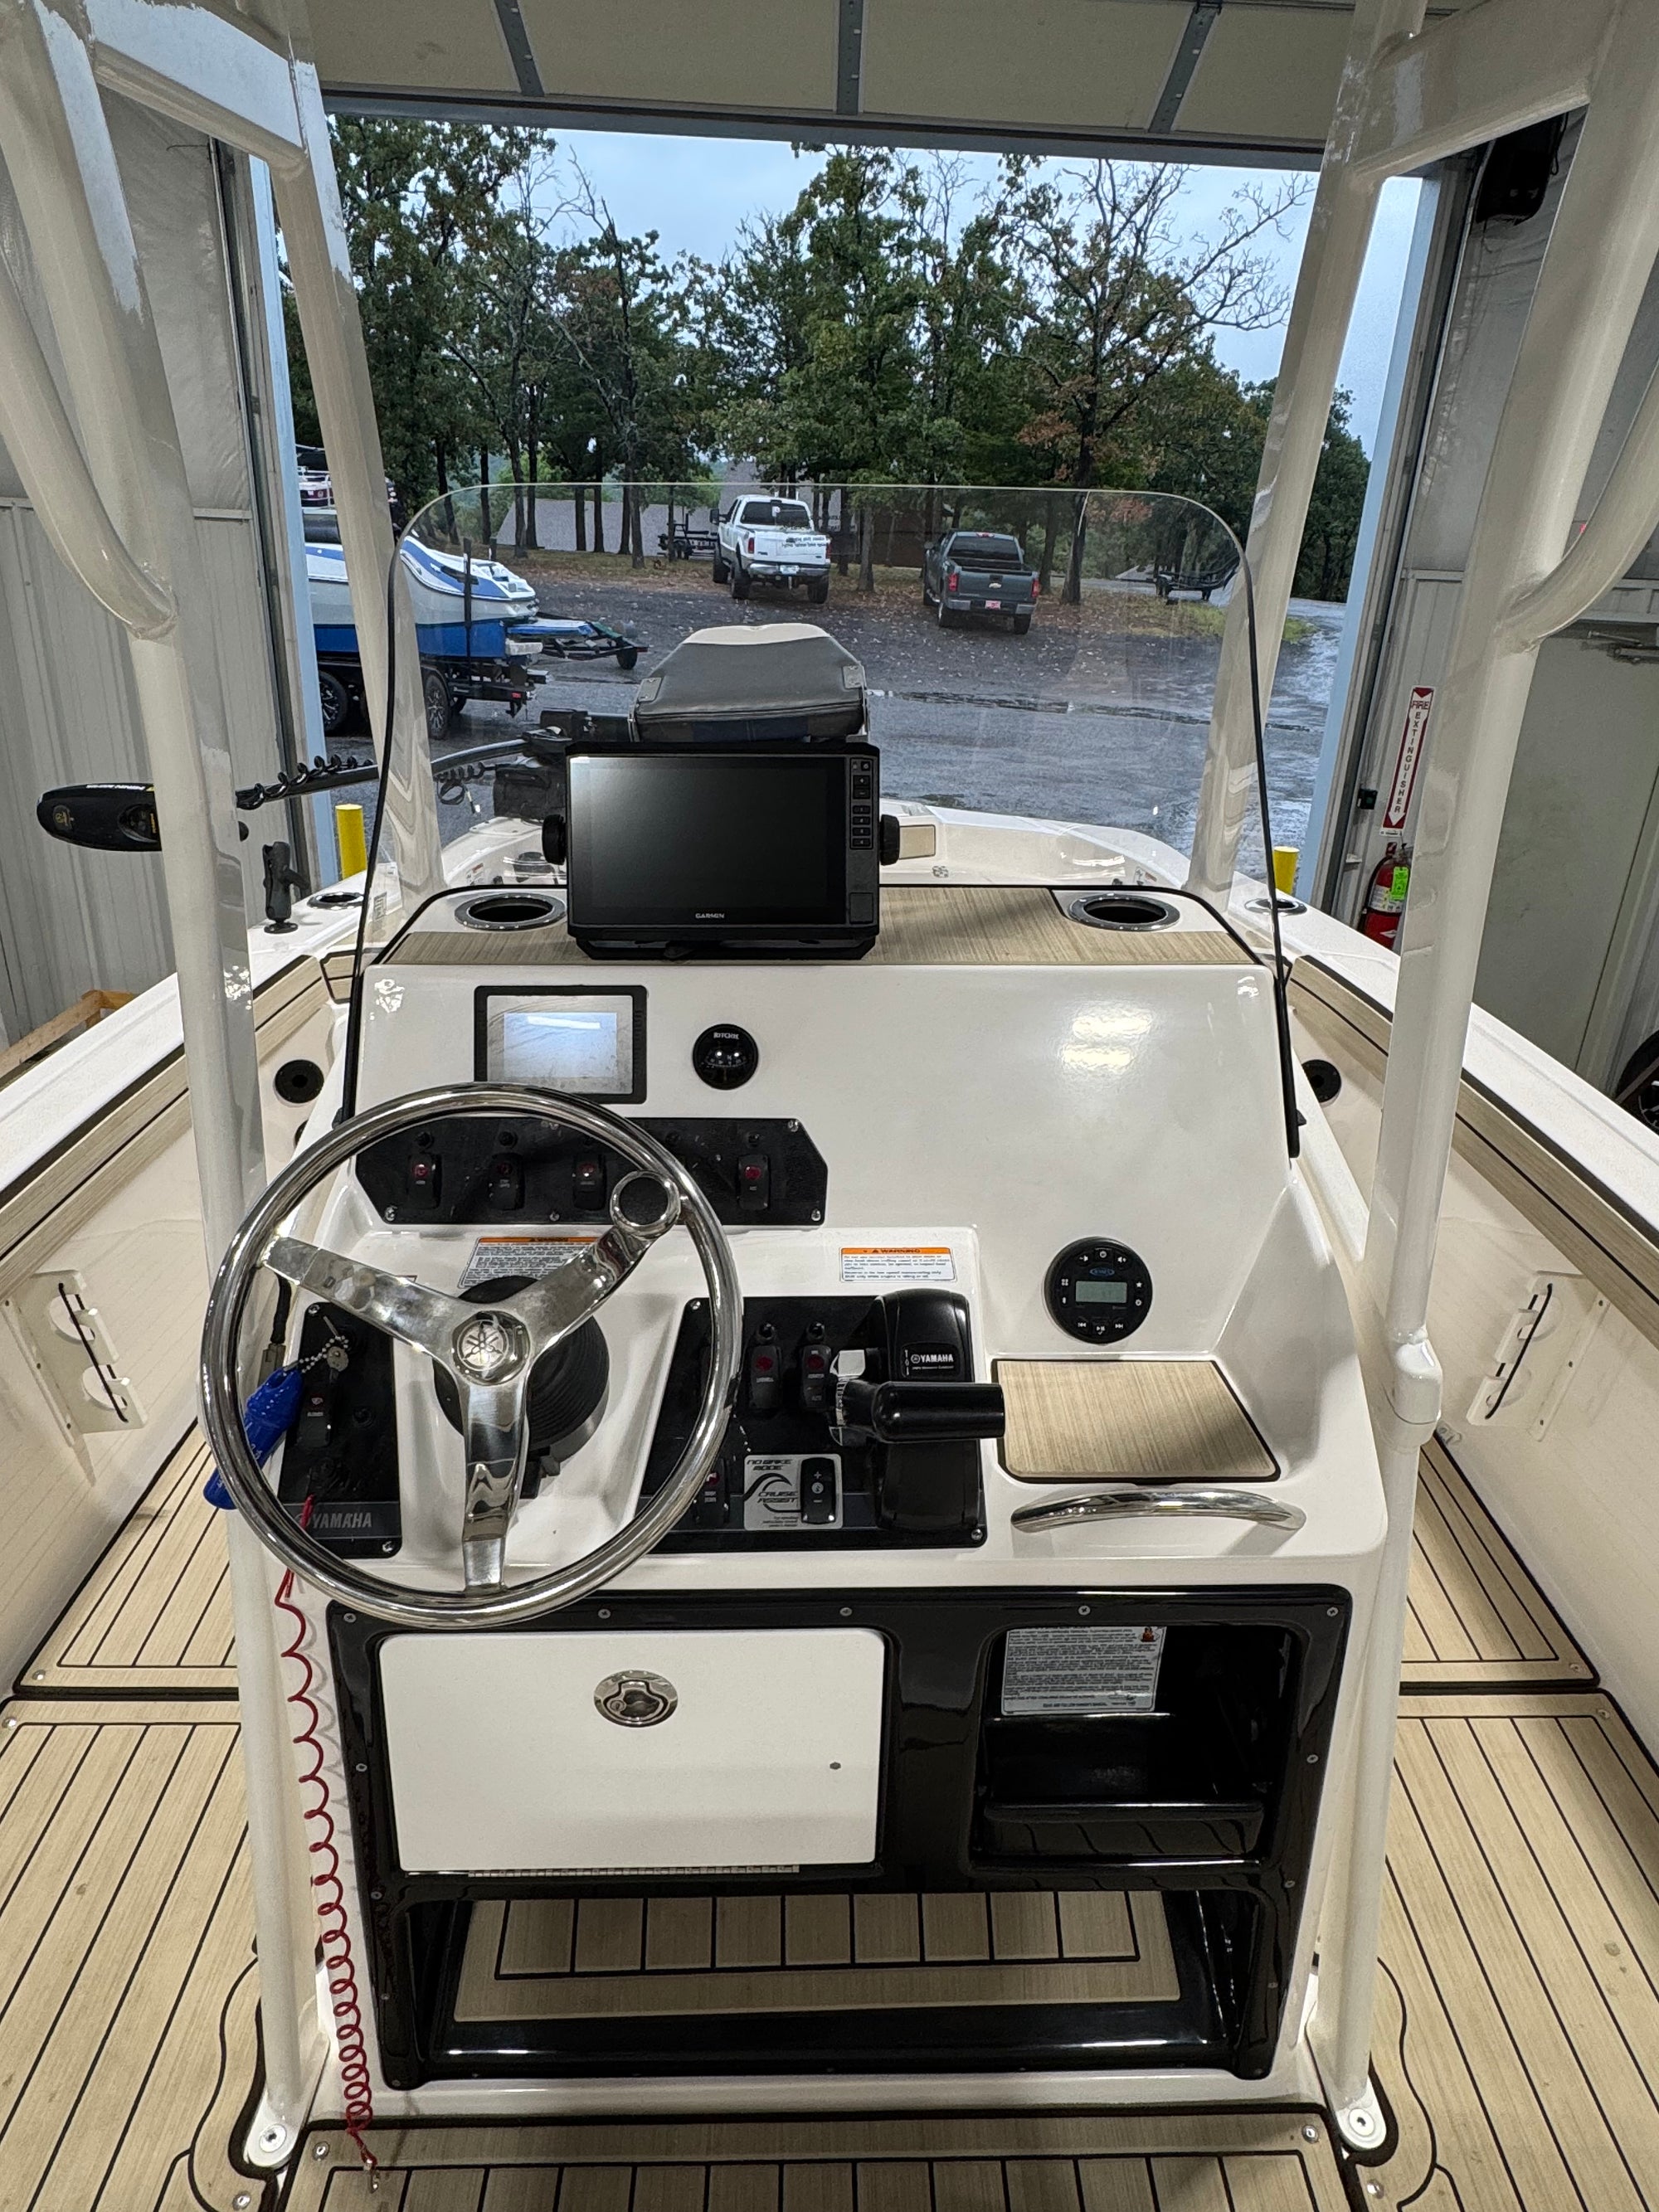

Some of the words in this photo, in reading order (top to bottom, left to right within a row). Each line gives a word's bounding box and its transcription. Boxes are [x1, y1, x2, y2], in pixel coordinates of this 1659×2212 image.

[1411, 701, 1430, 710] FIRE
[1394, 711, 1421, 813] EXTINGUISHER
[920, 1354, 954, 1363] YAMAHA
[313, 1512, 372, 1529] YAMAHA
